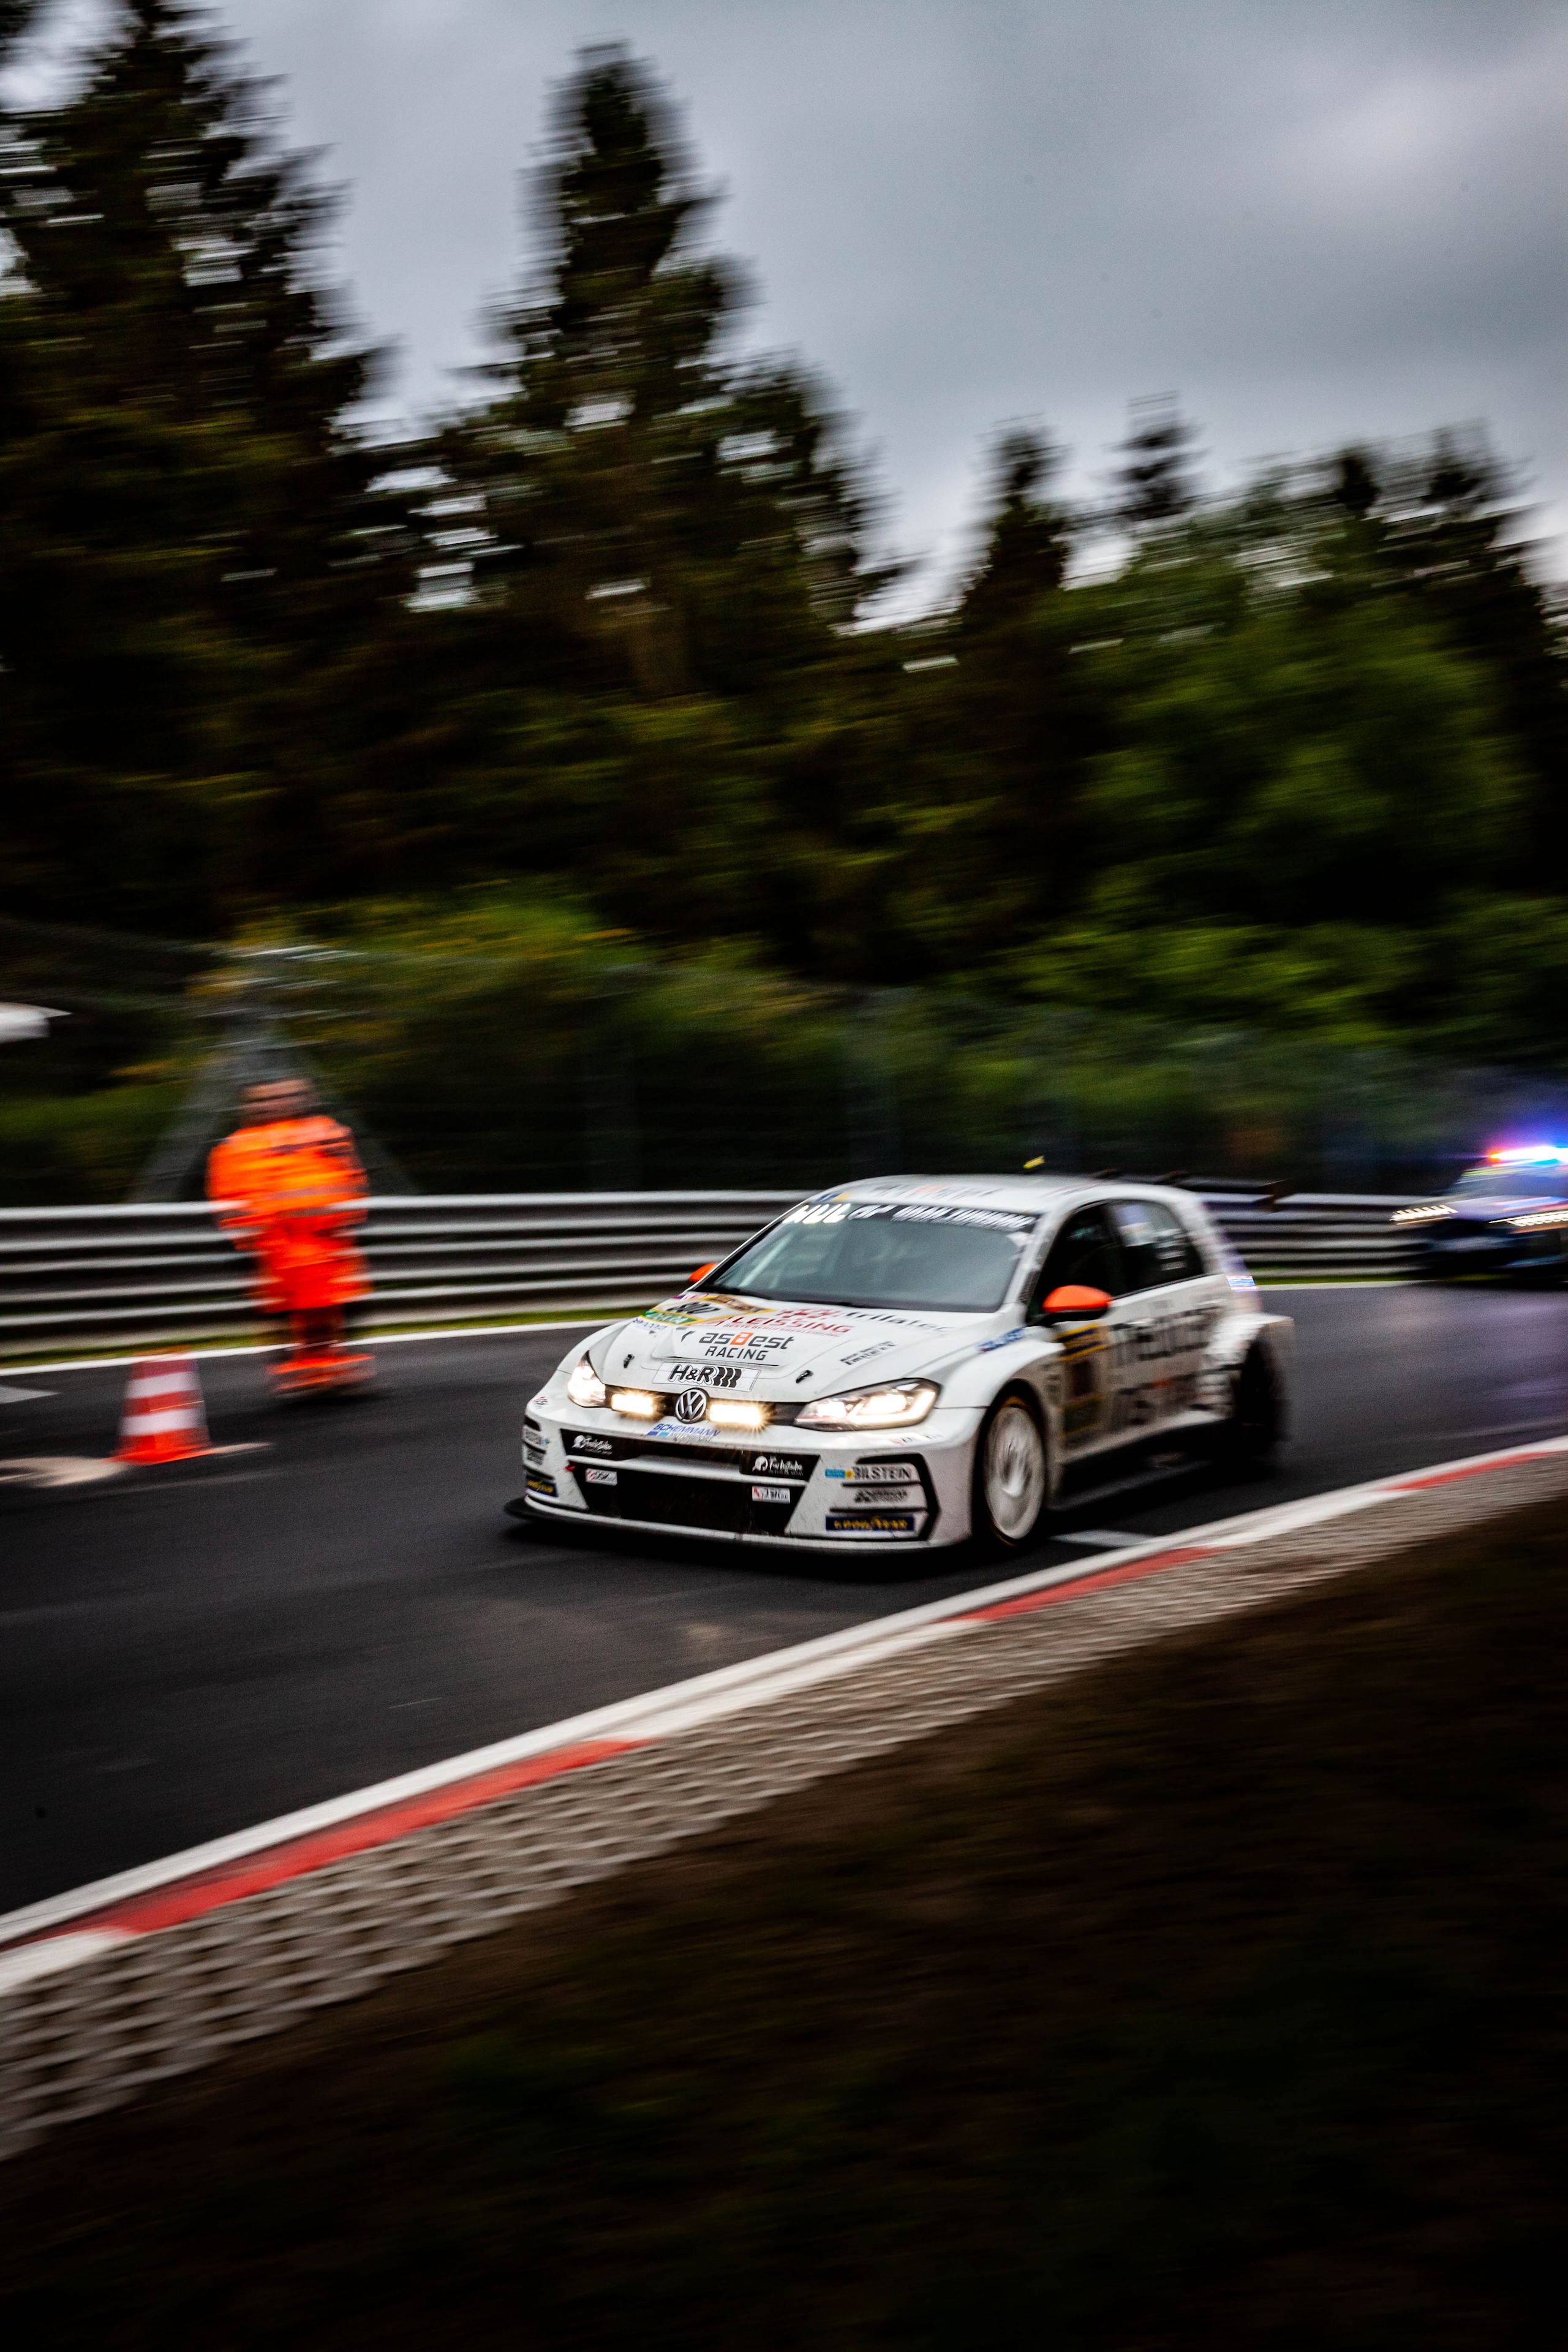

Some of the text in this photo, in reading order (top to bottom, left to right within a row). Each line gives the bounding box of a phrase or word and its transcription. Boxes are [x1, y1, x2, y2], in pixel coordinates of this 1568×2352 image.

[732, 1317, 855, 1333] LEISSING
[698, 1332, 794, 1349] asBest
[704, 1346, 769, 1361] RACING
[668, 1363, 718, 1385] H&R
[853, 1466, 912, 1480] BILSTEIN
